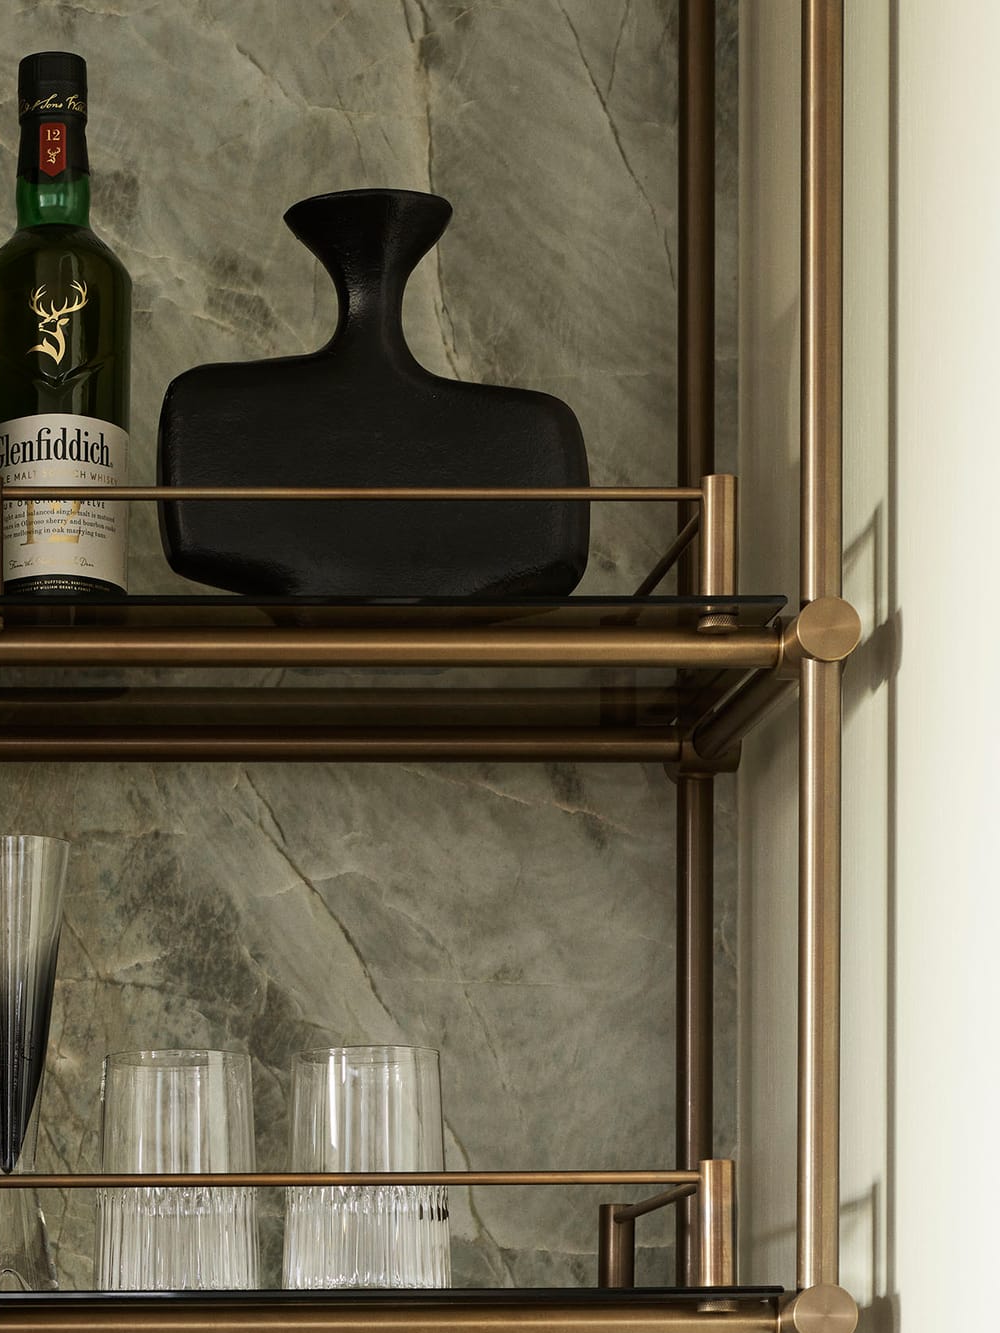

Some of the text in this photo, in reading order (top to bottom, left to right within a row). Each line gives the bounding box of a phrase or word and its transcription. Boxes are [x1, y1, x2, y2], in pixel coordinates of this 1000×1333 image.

[46, 129, 61, 141] 12
[14, 470, 37, 481] MALT
[90, 472, 120, 486] WHISKY
